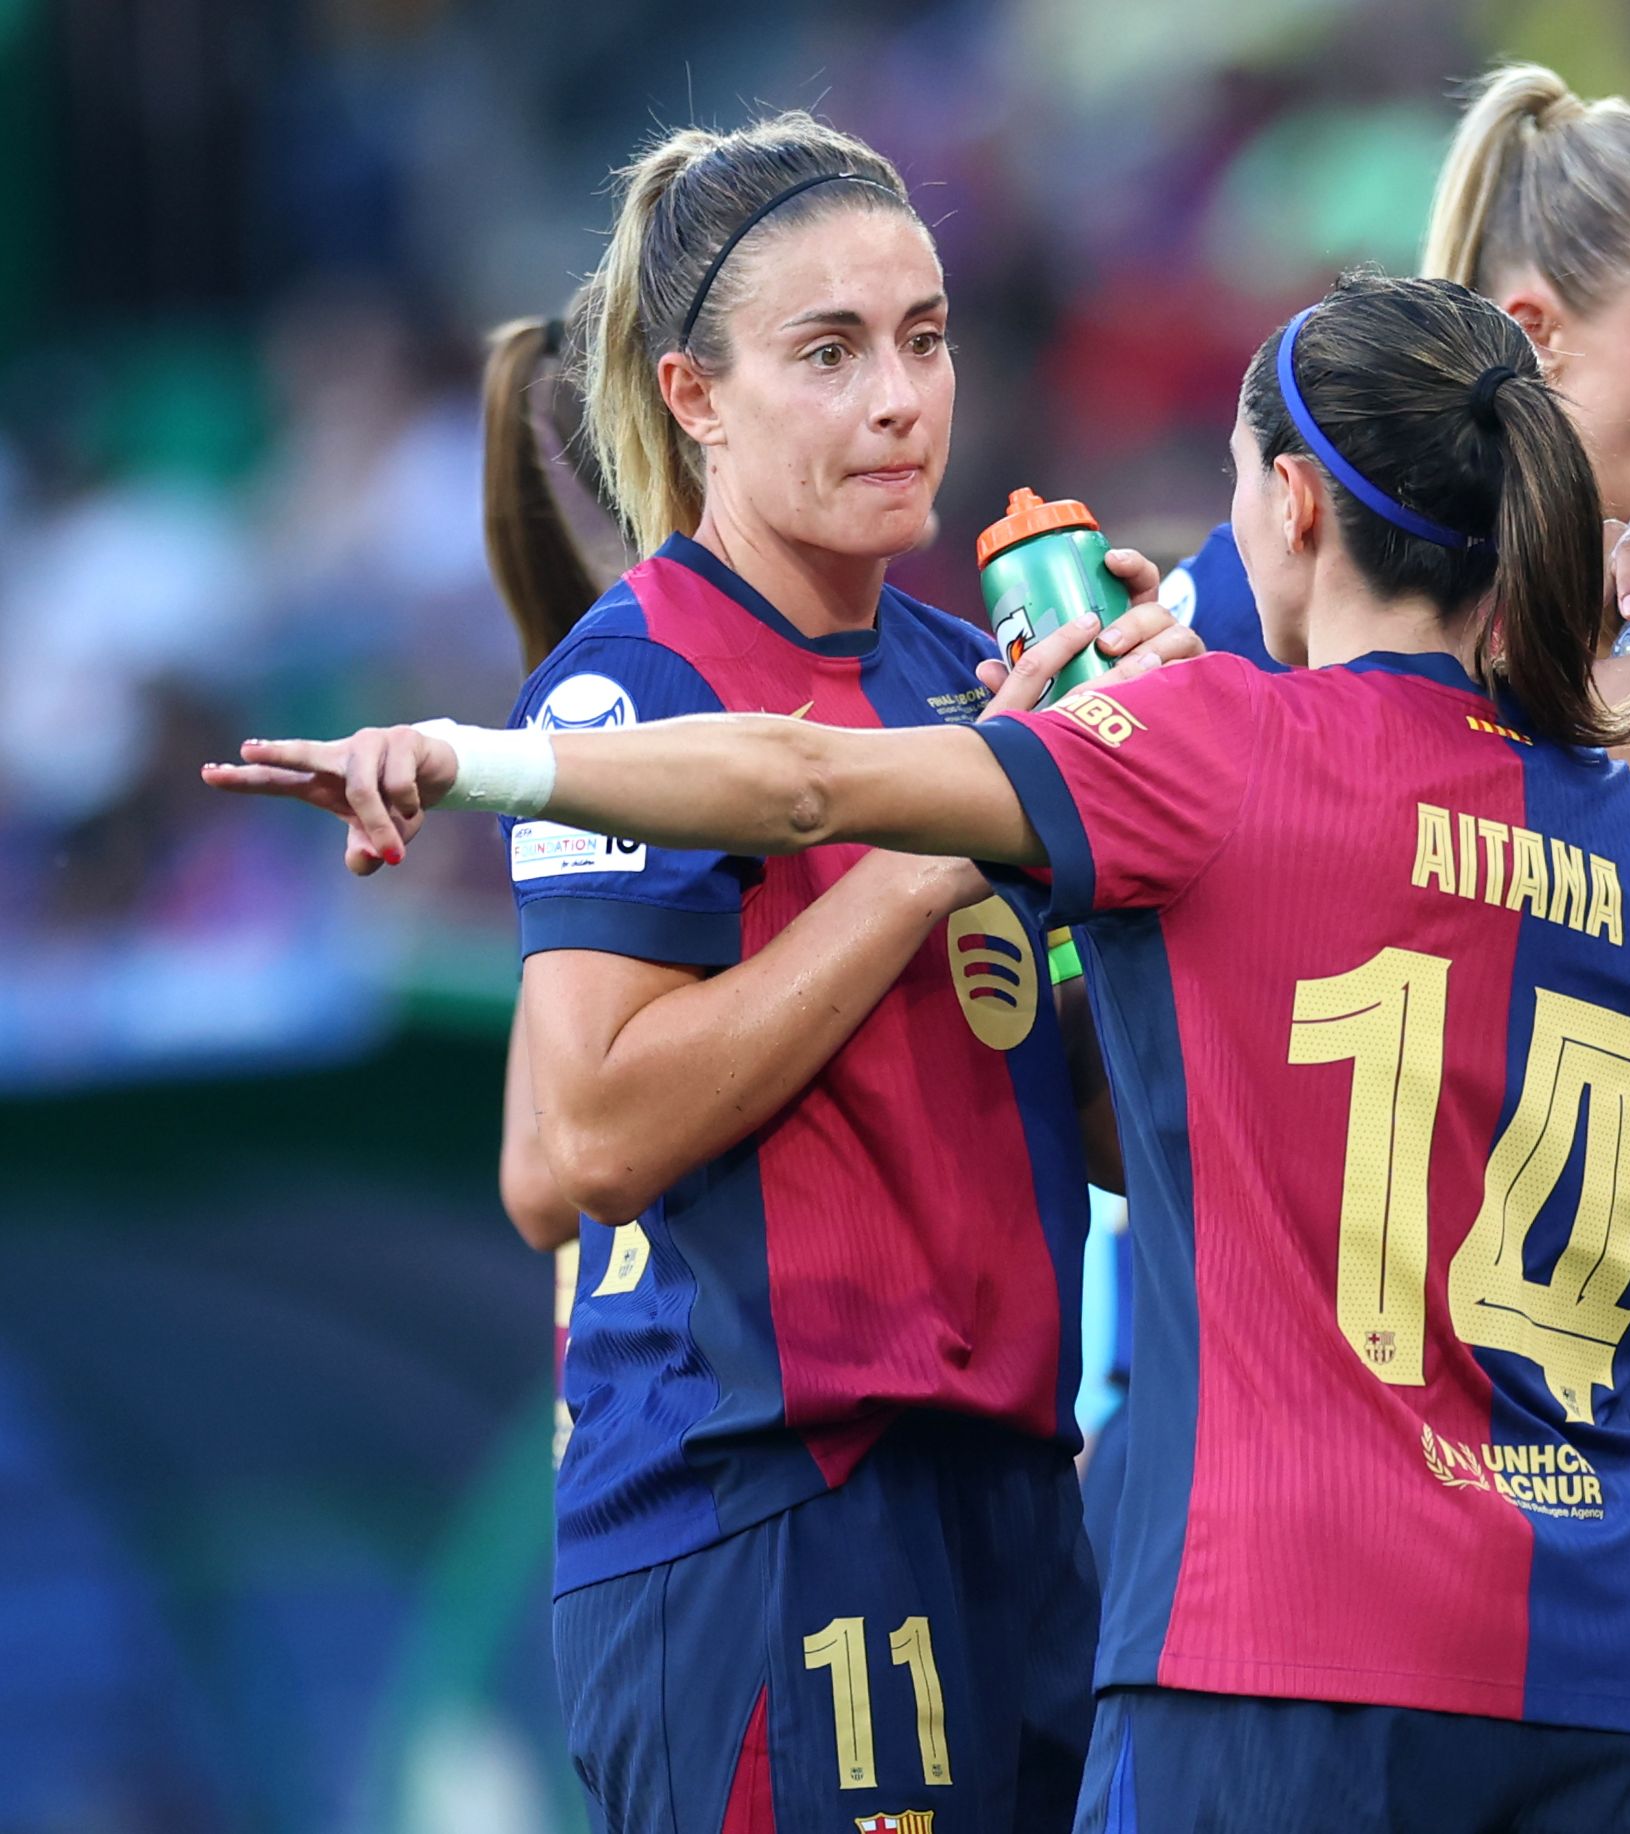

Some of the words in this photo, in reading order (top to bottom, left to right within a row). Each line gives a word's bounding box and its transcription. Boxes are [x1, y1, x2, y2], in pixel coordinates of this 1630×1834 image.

[514, 838, 598, 857] FOUNDATION
[1412, 802, 1624, 946] AITANA
[1493, 1473, 1603, 1505] ACNUR
[1570, 1506, 1604, 1520] Agency
[803, 1616, 953, 1789] 11
